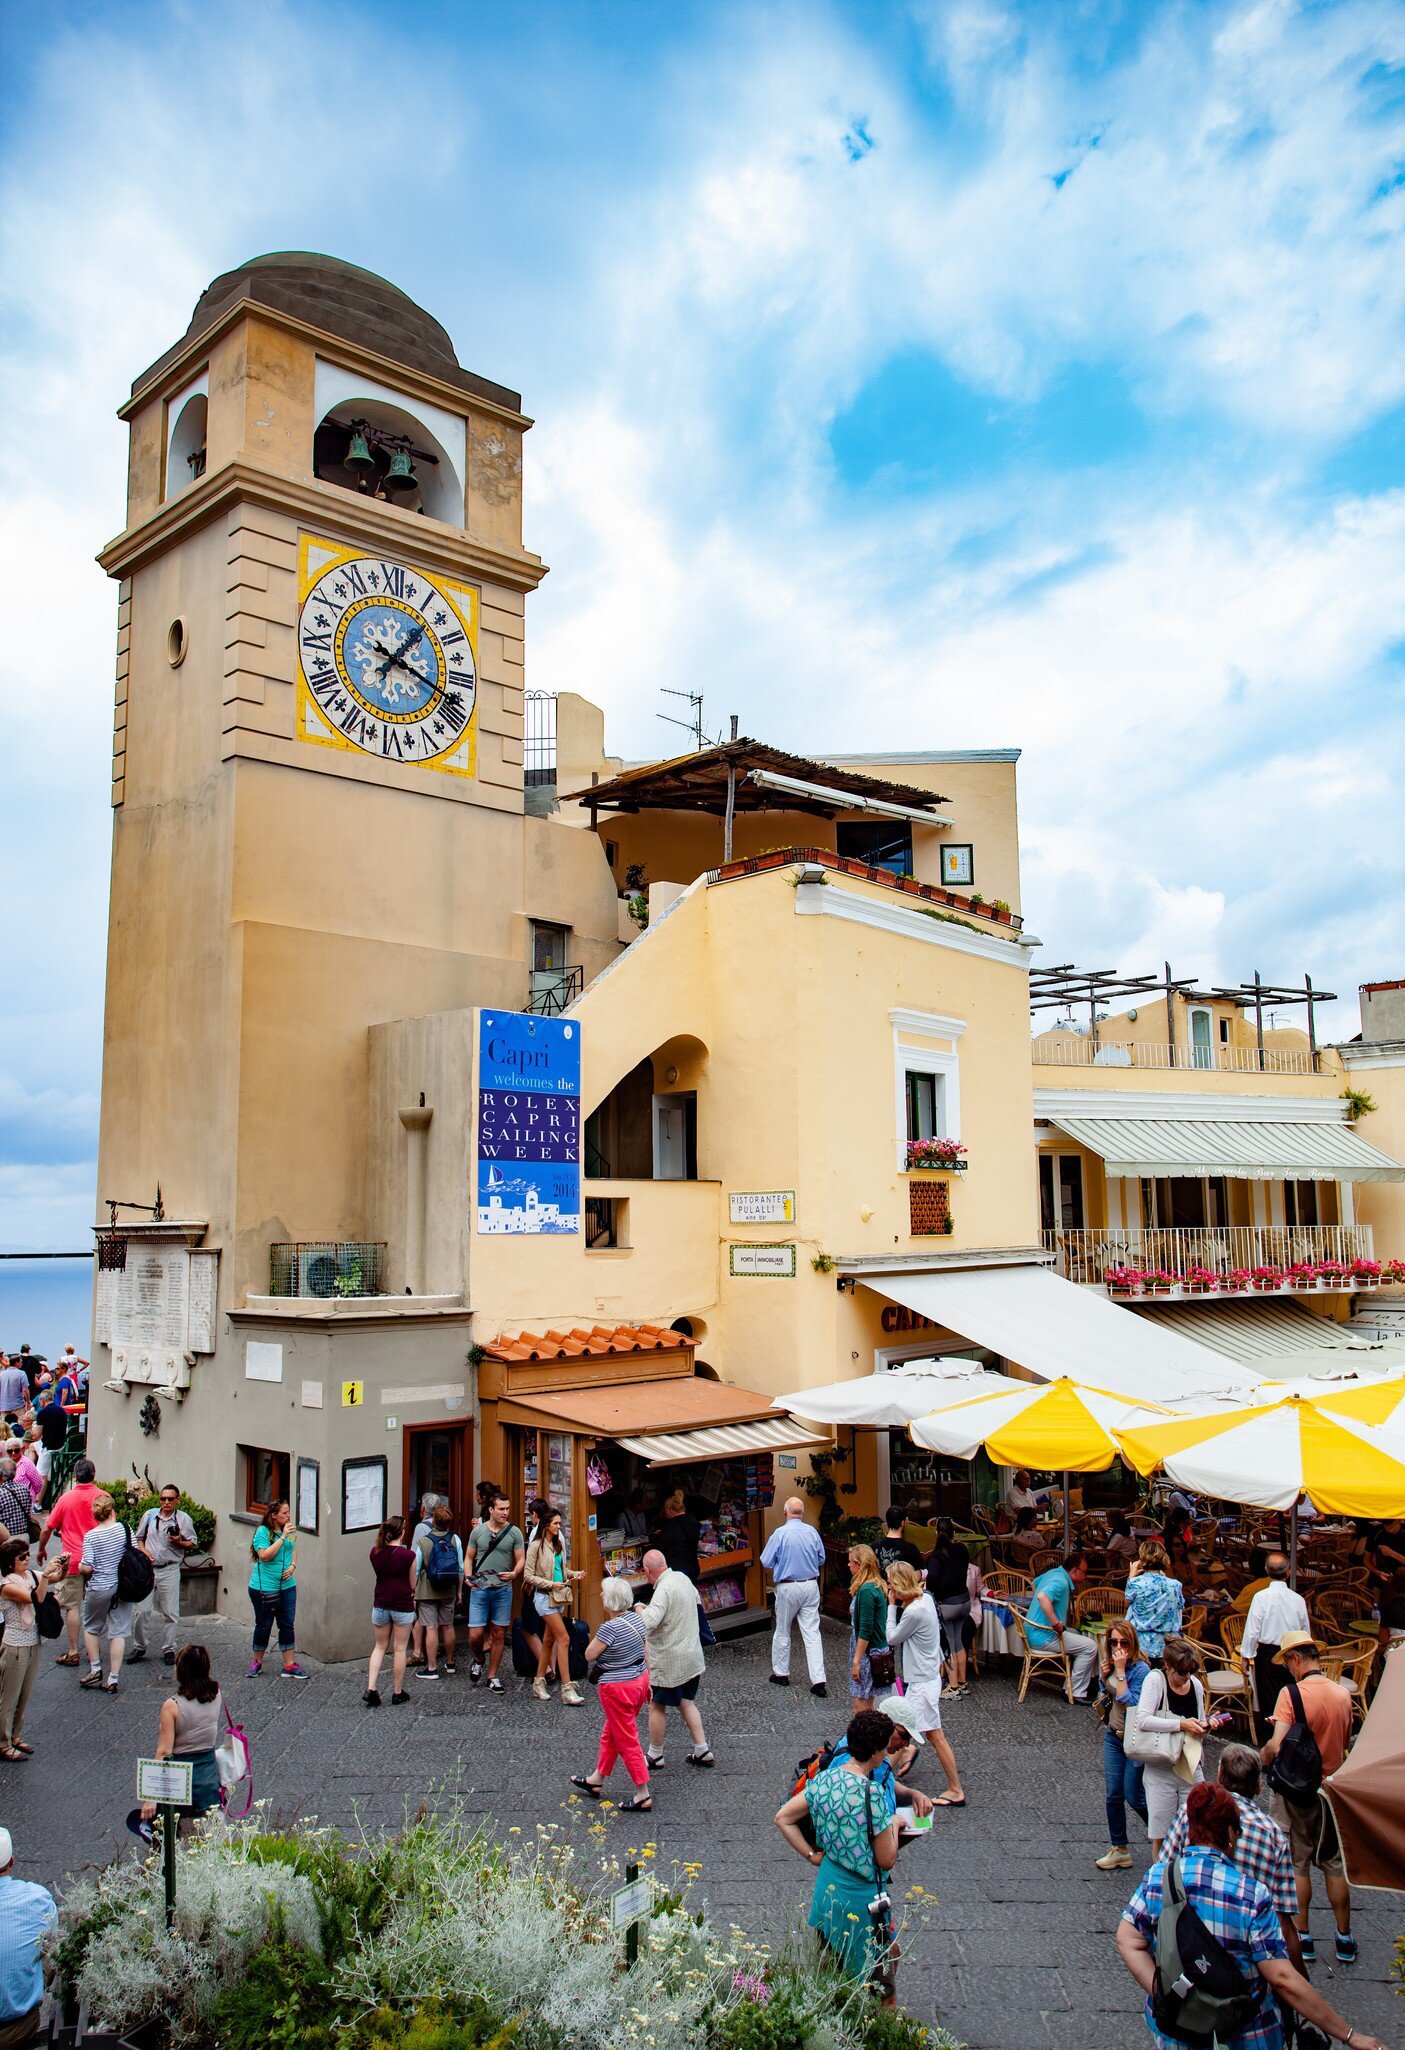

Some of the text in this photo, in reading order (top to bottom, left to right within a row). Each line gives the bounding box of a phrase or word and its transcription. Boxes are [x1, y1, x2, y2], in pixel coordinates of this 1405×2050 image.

[339, 564, 368, 598] XI
[380, 562, 405, 599] XII
[312, 587, 344, 619] X
[419, 589, 437, 613] I
[303, 626, 332, 653] IX
[440, 630, 465, 647] II
[308, 668, 342, 709] VIII
[448, 670, 474, 690] III
[339, 704, 366, 745] VII
[382, 724, 404, 758] VI
[420, 726, 440, 755] V
[488, 1037, 549, 1075] Capri
[494, 1072, 574, 1091] welcomes the
[482, 1093, 577, 1112] ROLEX
[482, 1110, 577, 1128] CAPRI
[482, 1127, 577, 1144] SAILING
[481, 1144, 577, 1160] WEEK
[1253, 1167, 1276, 1177] Bar
[1307, 1168, 1336, 1178] Room
[552, 1183, 576, 1198] 2014
[731, 1195, 781, 1205] RISTORANTE
[738, 1205, 775, 1214] PULALLI
